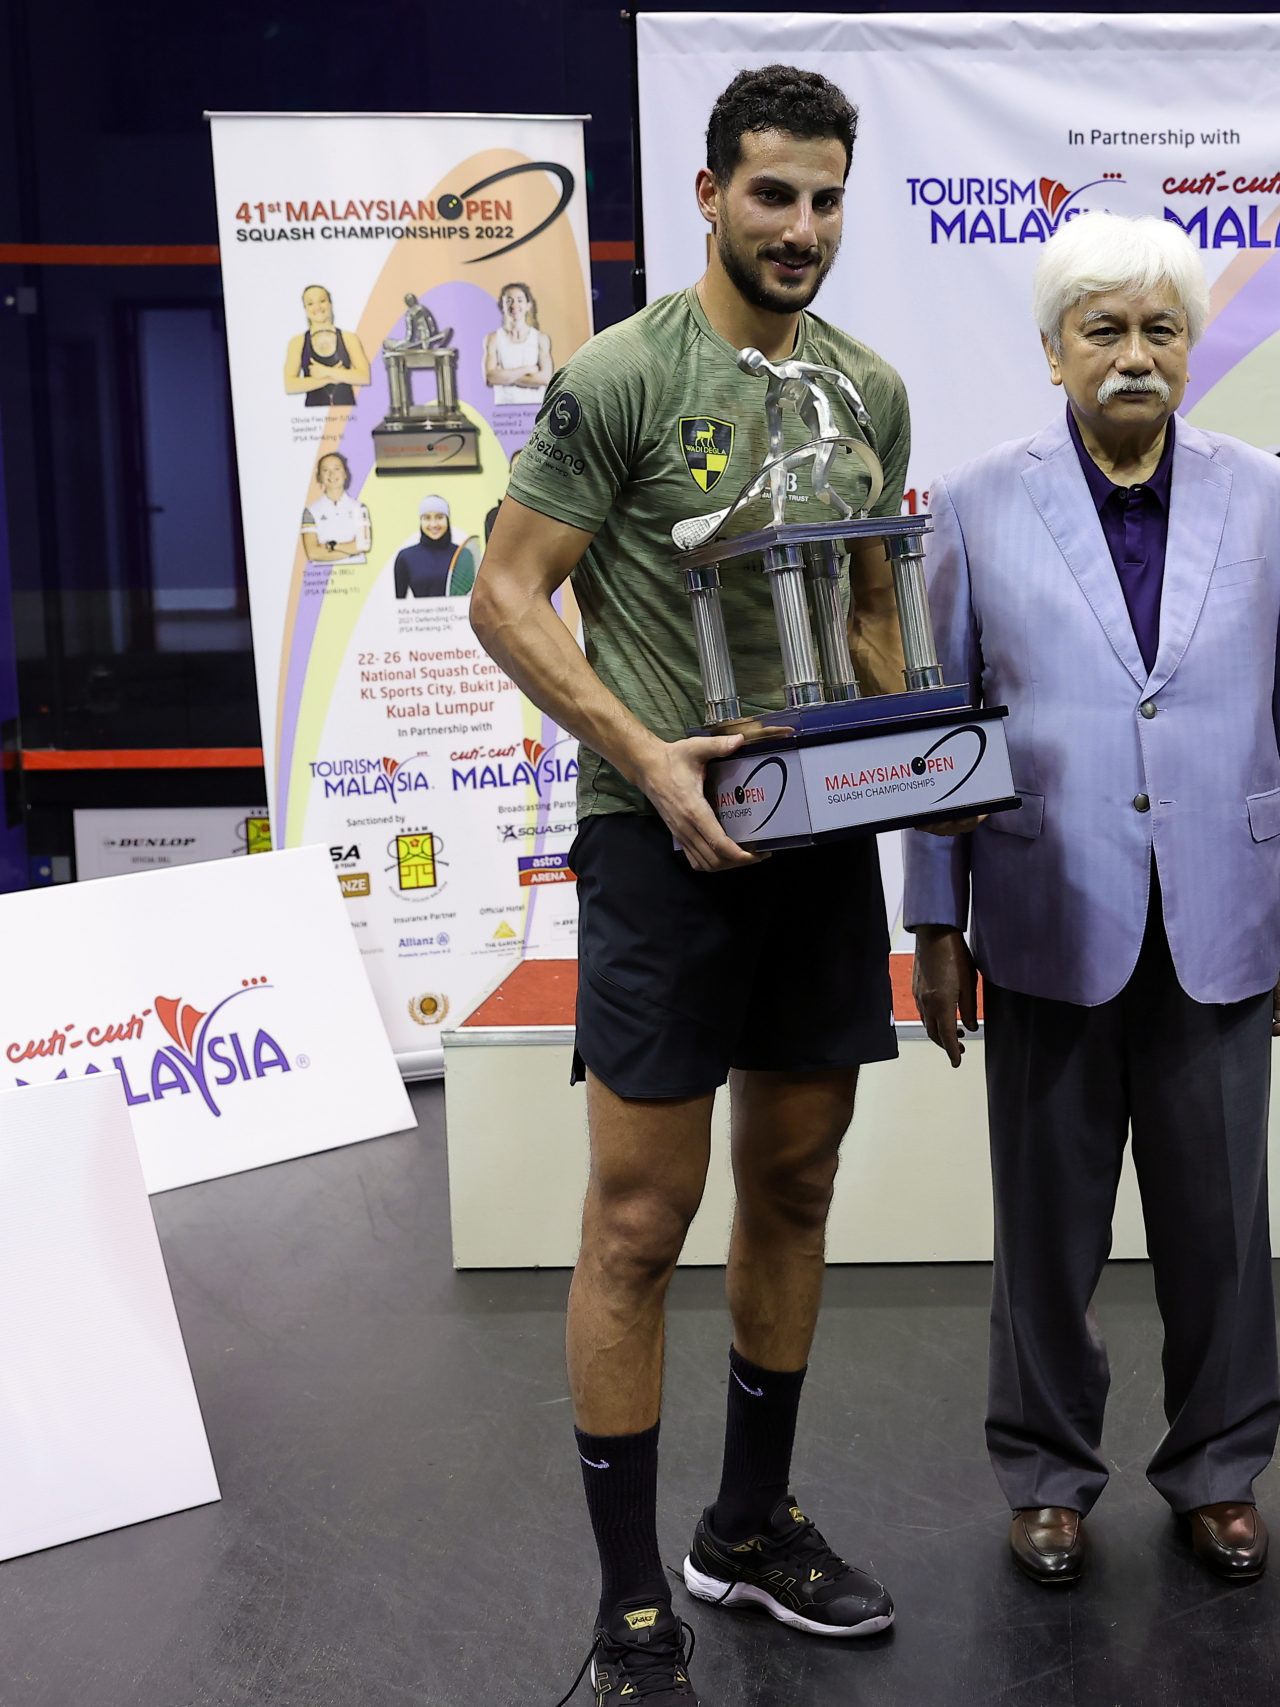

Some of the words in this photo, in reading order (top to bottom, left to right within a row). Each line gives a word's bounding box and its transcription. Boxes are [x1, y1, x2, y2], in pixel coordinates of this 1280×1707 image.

[1067, 129, 1085, 146] In
[1091, 128, 1196, 149] Partnership
[1200, 128, 1241, 146] with
[907, 177, 1037, 206] TOURISM
[235, 201, 282, 224] 41st
[236, 226, 315, 242] SQUASH
[320, 226, 470, 240] CHAMPIONSHIPS
[474, 225, 515, 239] 2022
[685, 444, 703, 453] WADI
[703, 446, 727, 455] DEGLA
[788, 494, 809, 502] TRUST
[383, 651, 401, 663] 26
[409, 648, 480, 662] November,
[360, 667, 417, 682] National
[420, 664, 469, 680] Squash
[472, 663, 502, 676] Cent
[360, 687, 376, 700] KL
[380, 685, 423, 700] Sports
[427, 682, 456, 697] City,
[460, 680, 495, 693] Bukit
[386, 703, 431, 719] Kuala
[435, 700, 496, 716] Lumpur
[398, 728, 408, 737] In
[410, 724, 469, 736] Partnership
[471, 722, 492, 732] with
[309, 758, 382, 778] TOURISM
[324, 772, 430, 804] MALAYSIA
[827, 788, 864, 805] SQUASH
[865, 777, 936, 798] CHAMPIONSHIPS
[498, 803, 551, 814] Broadcasting
[553, 800, 577, 809] Partn
[346, 816, 394, 828] Sanctioned
[395, 815, 406, 824] by
[518, 823, 579, 836] SQUASHT
[119, 837, 197, 848] DUNLOP
[329, 844, 361, 862] SA
[532, 856, 562, 868] astro
[530, 871, 567, 884] ARENA
[393, 913, 428, 924] Insurance
[430, 911, 457, 921] Partner
[398, 935, 434, 949] Allianz
[6, 1008, 152, 1064] cuti-cuti
